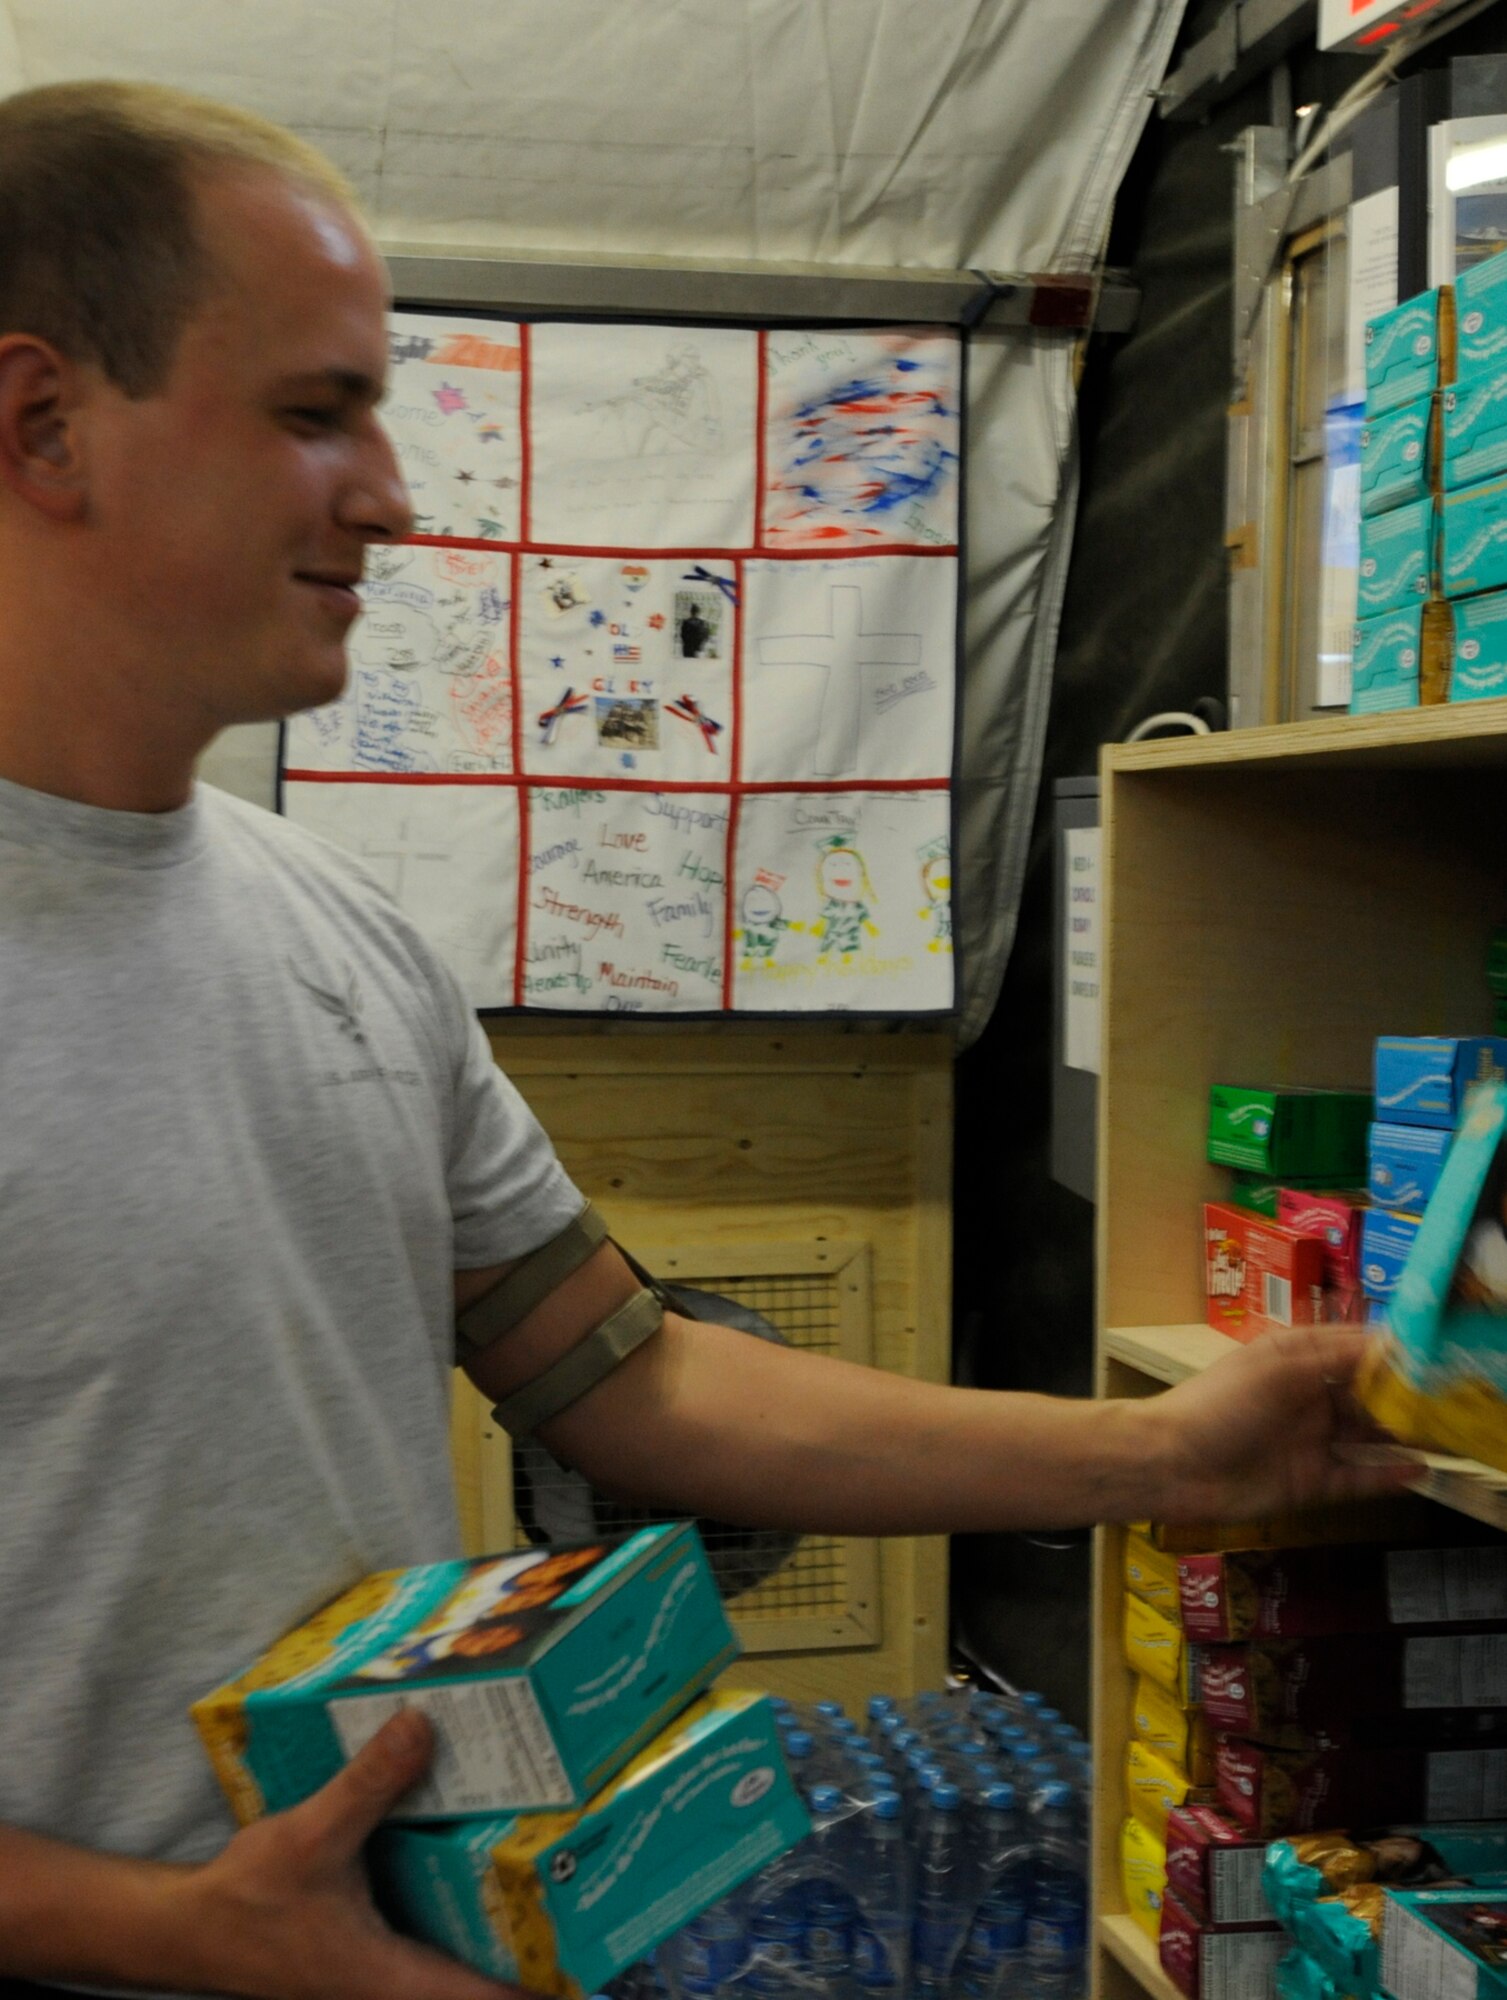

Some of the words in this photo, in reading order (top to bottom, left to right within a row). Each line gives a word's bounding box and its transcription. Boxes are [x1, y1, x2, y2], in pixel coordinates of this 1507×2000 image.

[599, 823, 649, 852] Love
[583, 858, 665, 888] America
[530, 885, 625, 941] Strength
[647, 892, 713, 938] Family
[597, 962, 681, 998] Maintain
